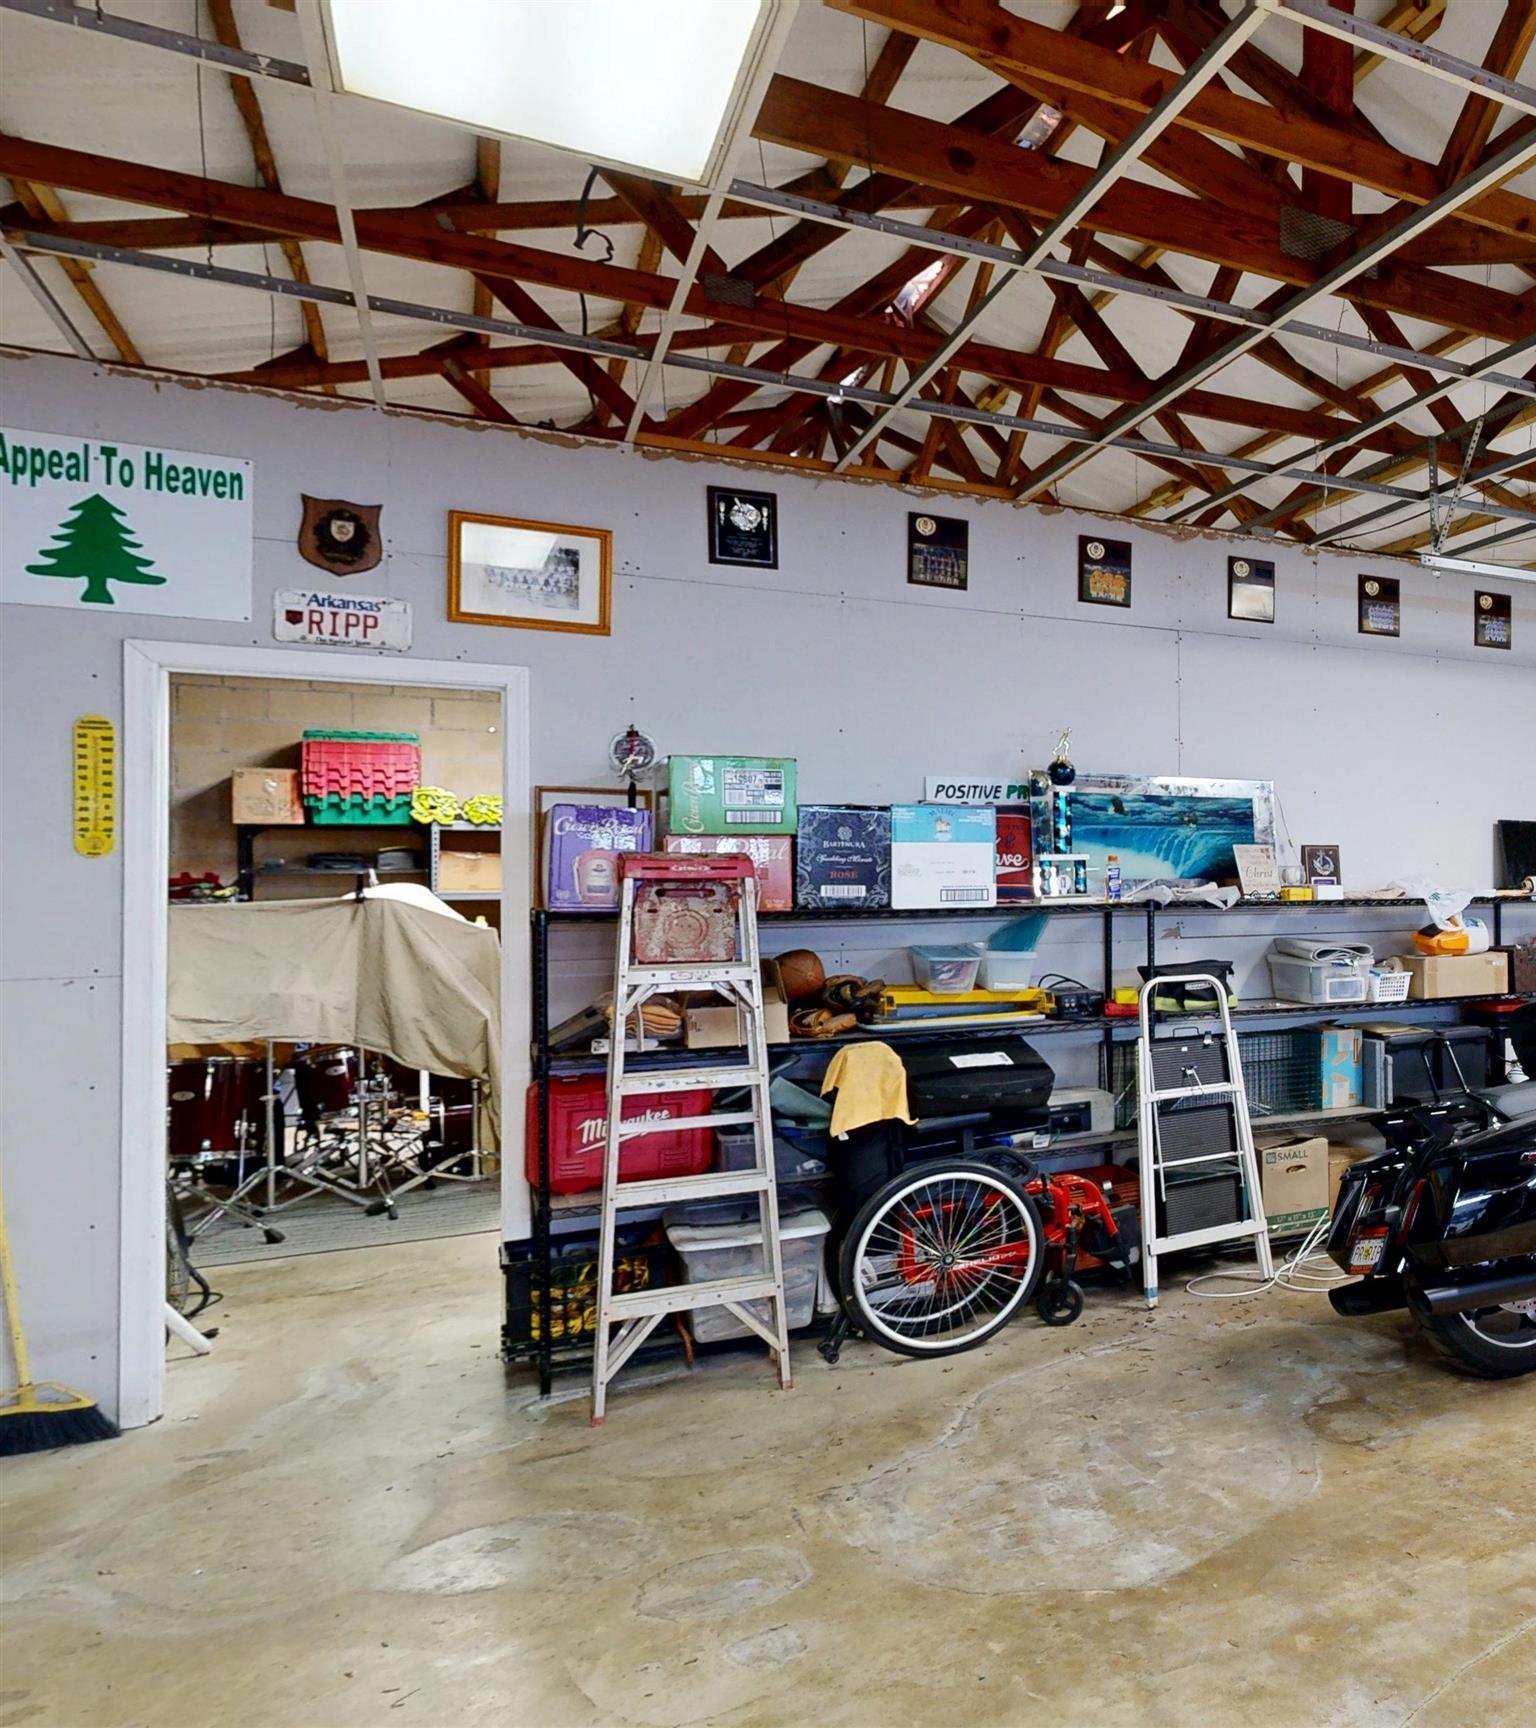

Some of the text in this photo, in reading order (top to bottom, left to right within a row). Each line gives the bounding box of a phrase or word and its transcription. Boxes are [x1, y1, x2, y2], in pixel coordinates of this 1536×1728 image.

[100, 445, 135, 488] To
[144, 451, 244, 500] Heaven
[306, 593, 382, 613] Arkansas
[308, 609, 379, 639] RIPP
[934, 784, 1002, 799] POSITIVE
[1277, 1150, 1309, 1161] SMALL
